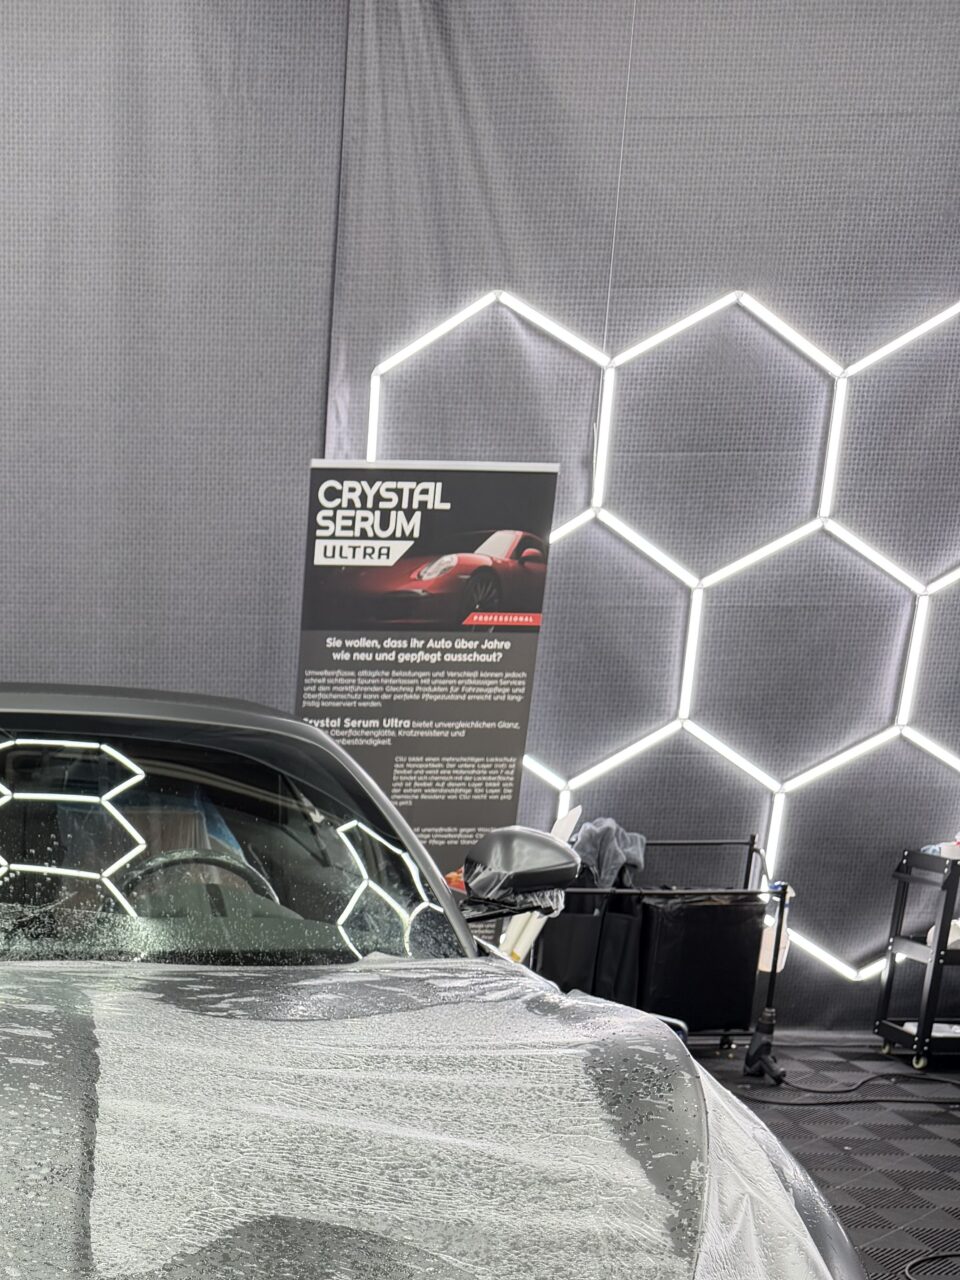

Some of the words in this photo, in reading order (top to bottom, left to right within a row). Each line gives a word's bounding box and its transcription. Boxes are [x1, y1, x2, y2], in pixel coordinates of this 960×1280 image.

[318, 480, 451, 510] CRYSTAL
[316, 510, 421, 538] SERUM
[323, 545, 390, 560] ULTRA
[473, 615, 533, 623] PROFESSIONAL
[326, 637, 341, 648] Sie
[345, 638, 381, 650] wollen,
[383, 638, 407, 648] dass
[426, 638, 453, 649] Auto
[454, 638, 479, 649] über
[481, 639, 511, 650] Jahre
[332, 650, 350, 660] wie
[353, 651, 372, 661] neu
[375, 650, 394, 661] und
[397, 651, 442, 664] gepflegt
[444, 651, 503, 662] ausschaut?
[303, 718, 340, 728] rystal
[344, 718, 380, 728] Serum
[383, 718, 411, 728] Ultra
